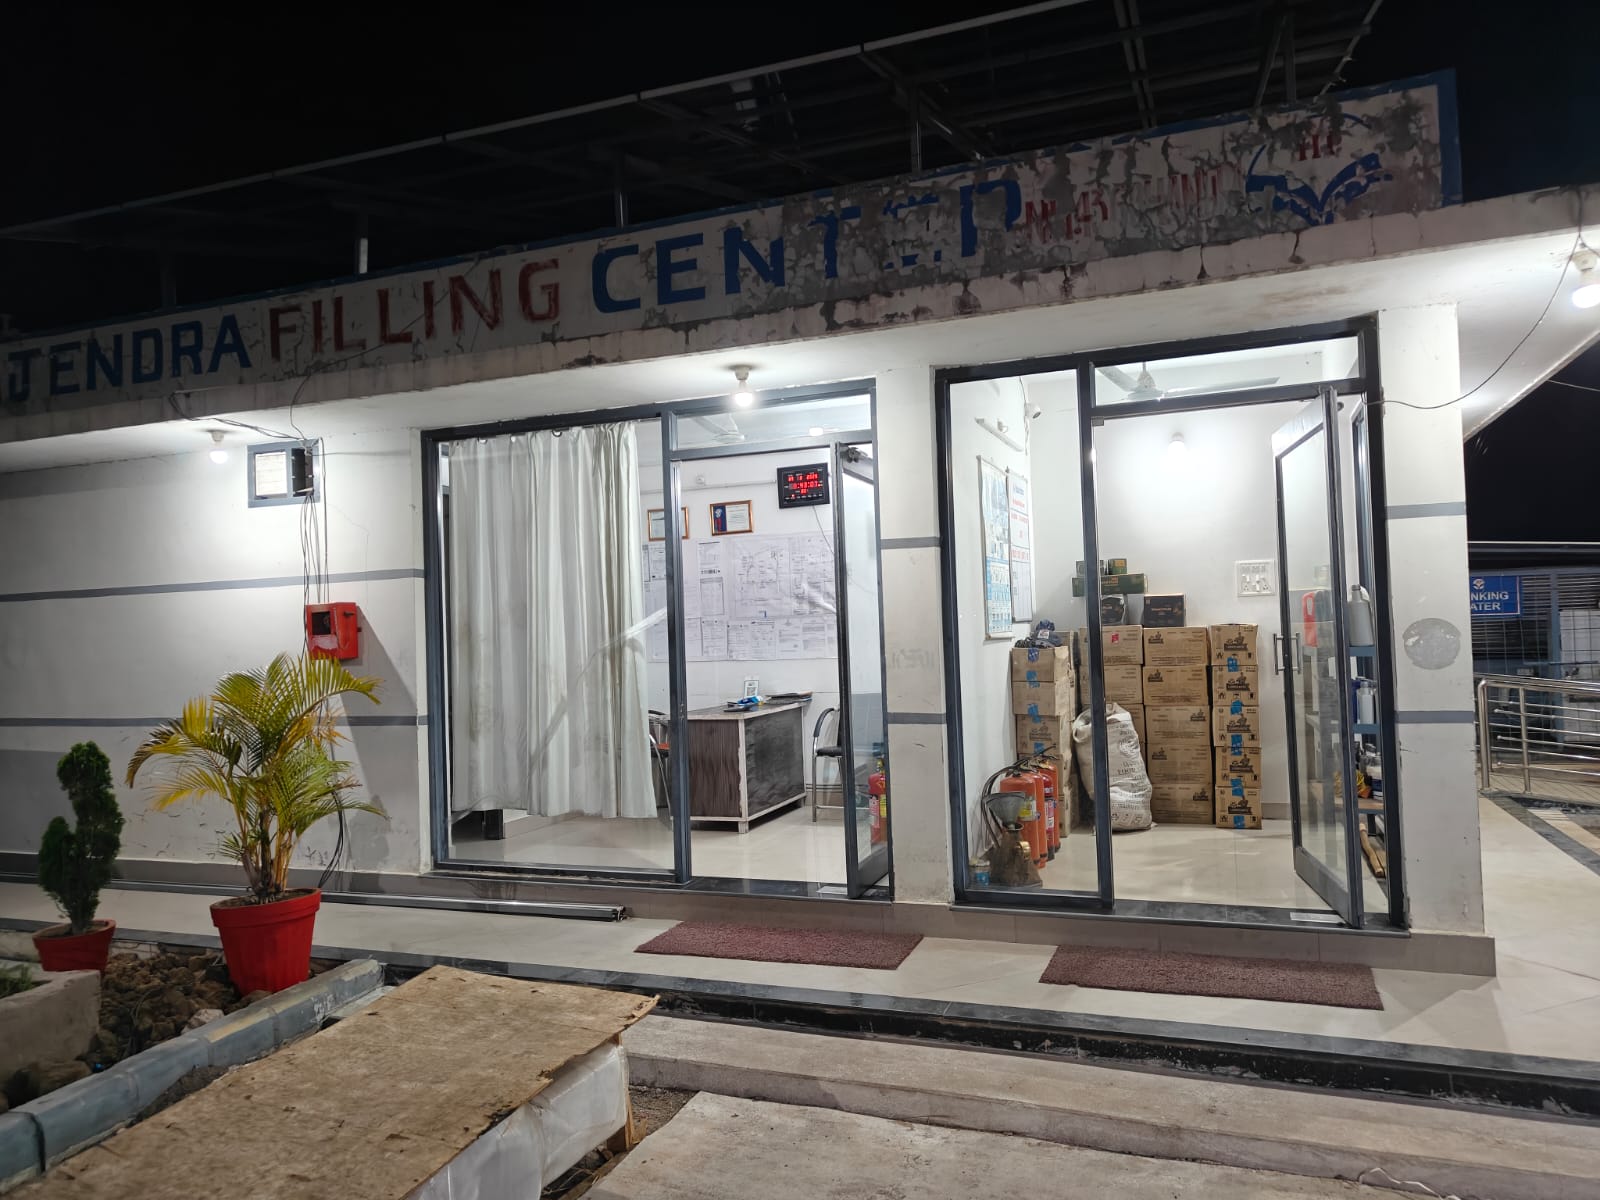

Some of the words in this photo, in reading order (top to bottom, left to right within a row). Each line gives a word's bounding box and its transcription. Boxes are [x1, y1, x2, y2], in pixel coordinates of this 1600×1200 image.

[8, 314, 252, 401] JENDRA
[269, 258, 561, 363] FILLING
[1471, 591, 1509, 601] NKING
[1471, 602, 1501, 611] ATER
